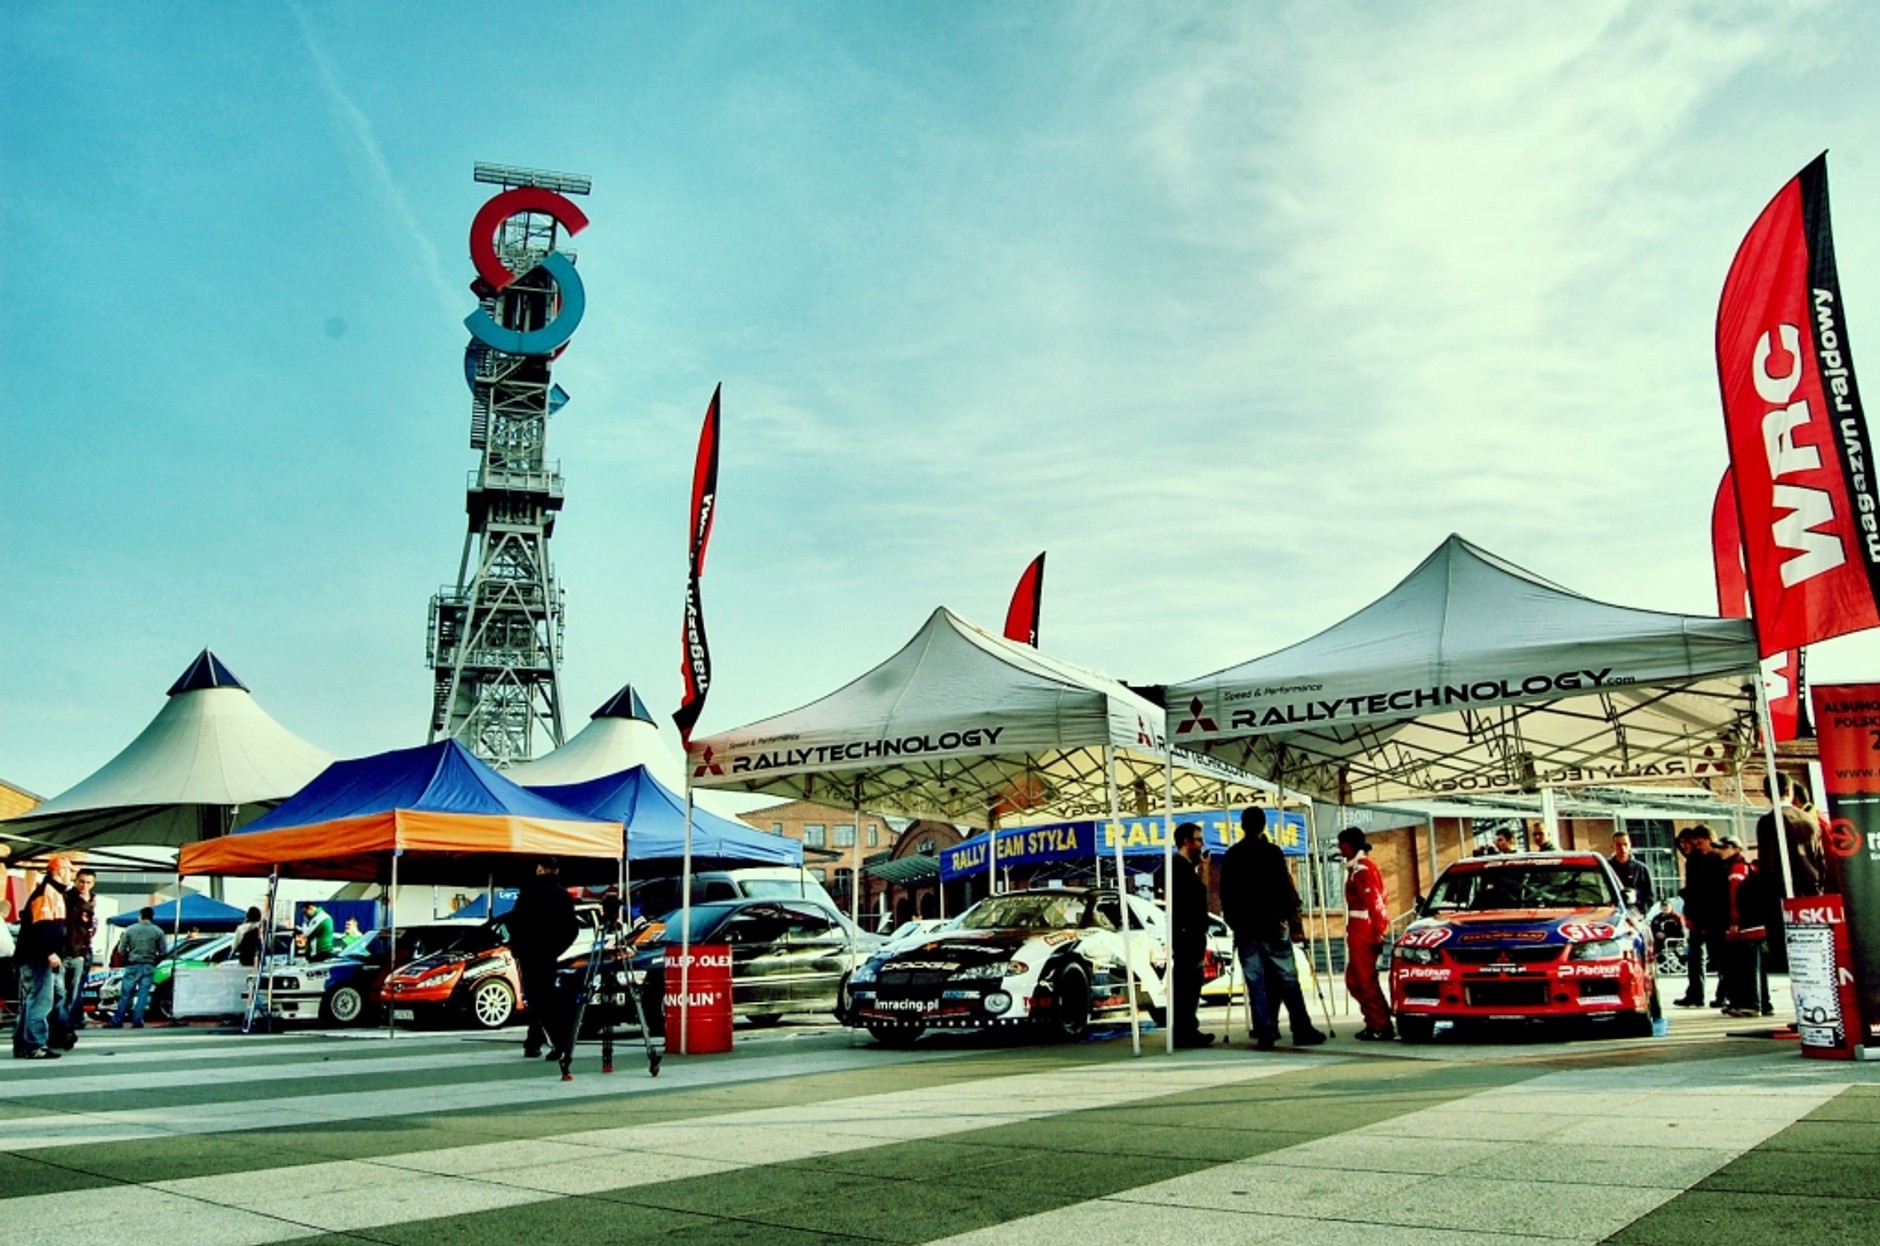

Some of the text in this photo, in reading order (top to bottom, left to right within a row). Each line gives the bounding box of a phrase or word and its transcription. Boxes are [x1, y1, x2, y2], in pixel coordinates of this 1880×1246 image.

[1812, 287, 1880, 563] magazyn rajdowy
[1753, 323, 1846, 589] WRC
[1224, 683, 1323, 701] Speed & Performance
[732, 727, 1004, 774] RALLYTECHNOLOGY
[952, 843, 987, 871] RALLY
[1408, 930, 1447, 947] STP
[1567, 924, 1607, 941] STP
[880, 961, 961, 971] DODGE
[1575, 965, 1621, 976] Platinum
